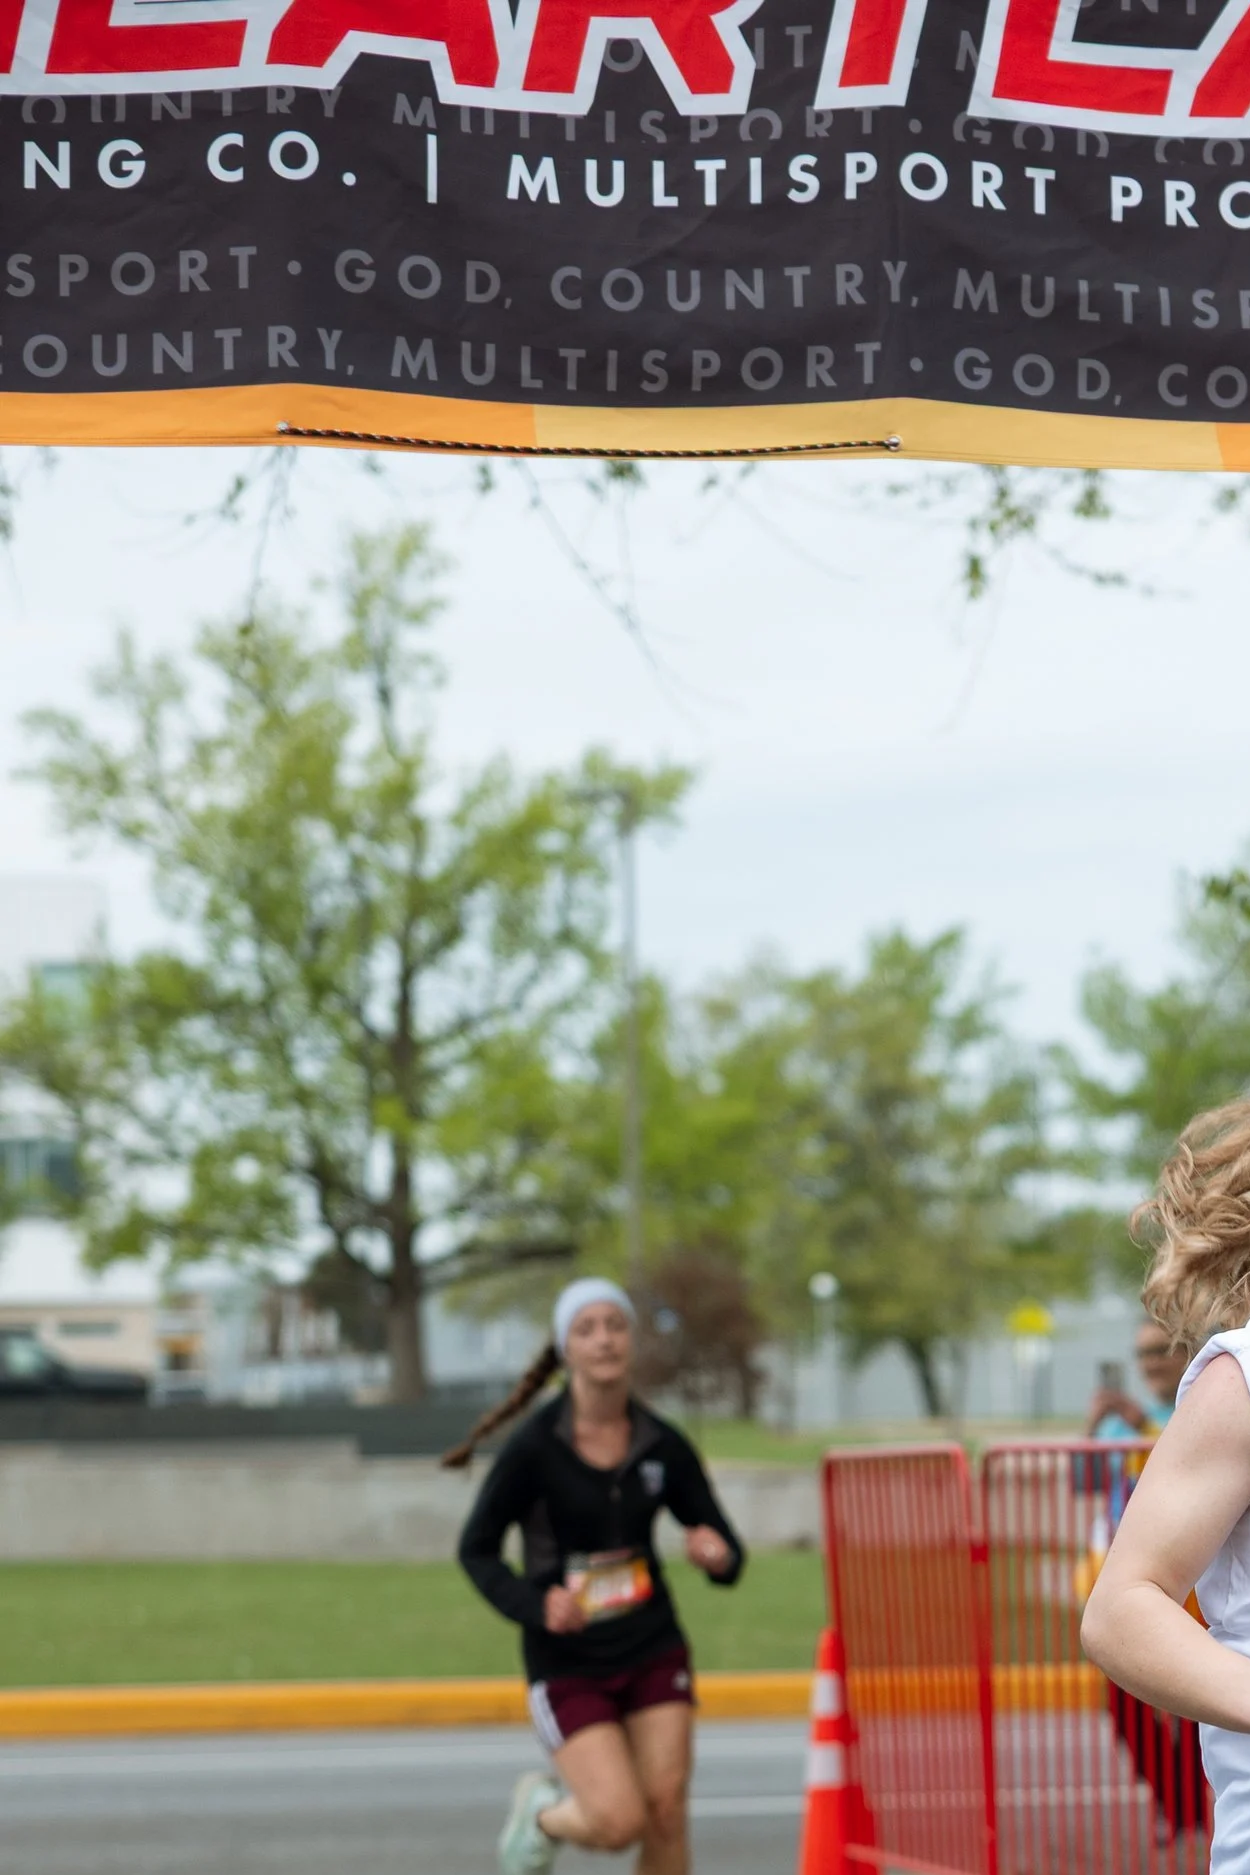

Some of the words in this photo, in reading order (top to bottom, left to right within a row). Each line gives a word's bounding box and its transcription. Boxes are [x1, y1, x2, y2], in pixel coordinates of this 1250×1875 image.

[23, 138, 147, 190] NG
[206, 130, 357, 187] CO.
[506, 151, 1056, 214] MULTISPORT
[4, 246, 258, 298] SPORT
[334, 248, 514, 310] GOD,
[549, 259, 919, 312] COUNTRY,
[0, 324, 356, 379] OUNTRY,
[391, 334, 882, 394] MULTISPORT
[952, 347, 1122, 407] GOD,
